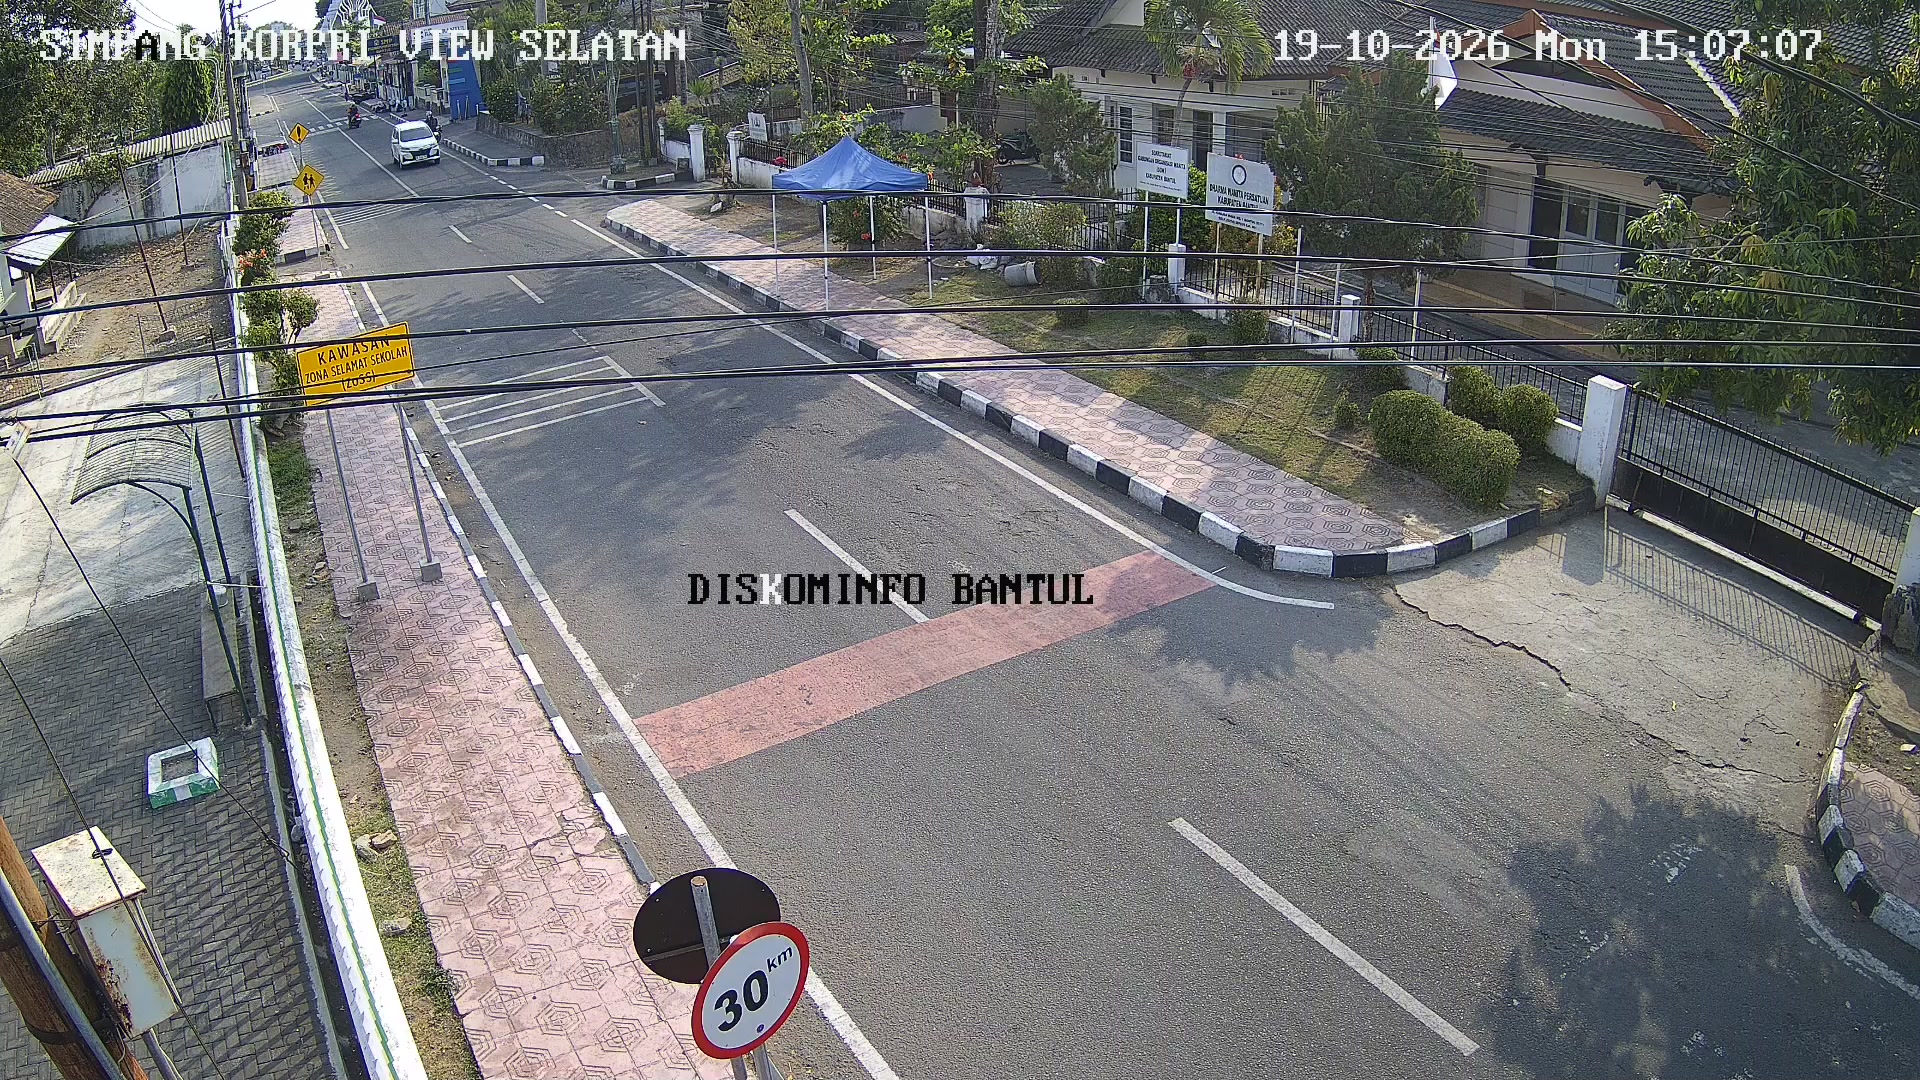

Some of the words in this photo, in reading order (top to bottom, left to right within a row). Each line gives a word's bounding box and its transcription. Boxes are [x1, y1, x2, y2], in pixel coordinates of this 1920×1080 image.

[1227, 187, 1244, 199] WANITA
[1244, 191, 1270, 205] PERSATUAN
[304, 370, 329, 385] ZONA
[332, 357, 369, 377] SELAMAT
[371, 345, 409, 366] SEKOLAH
[317, 338, 391, 366] KAWASAN
[714, 969, 769, 1032] 30
[766, 946, 793, 973] km
